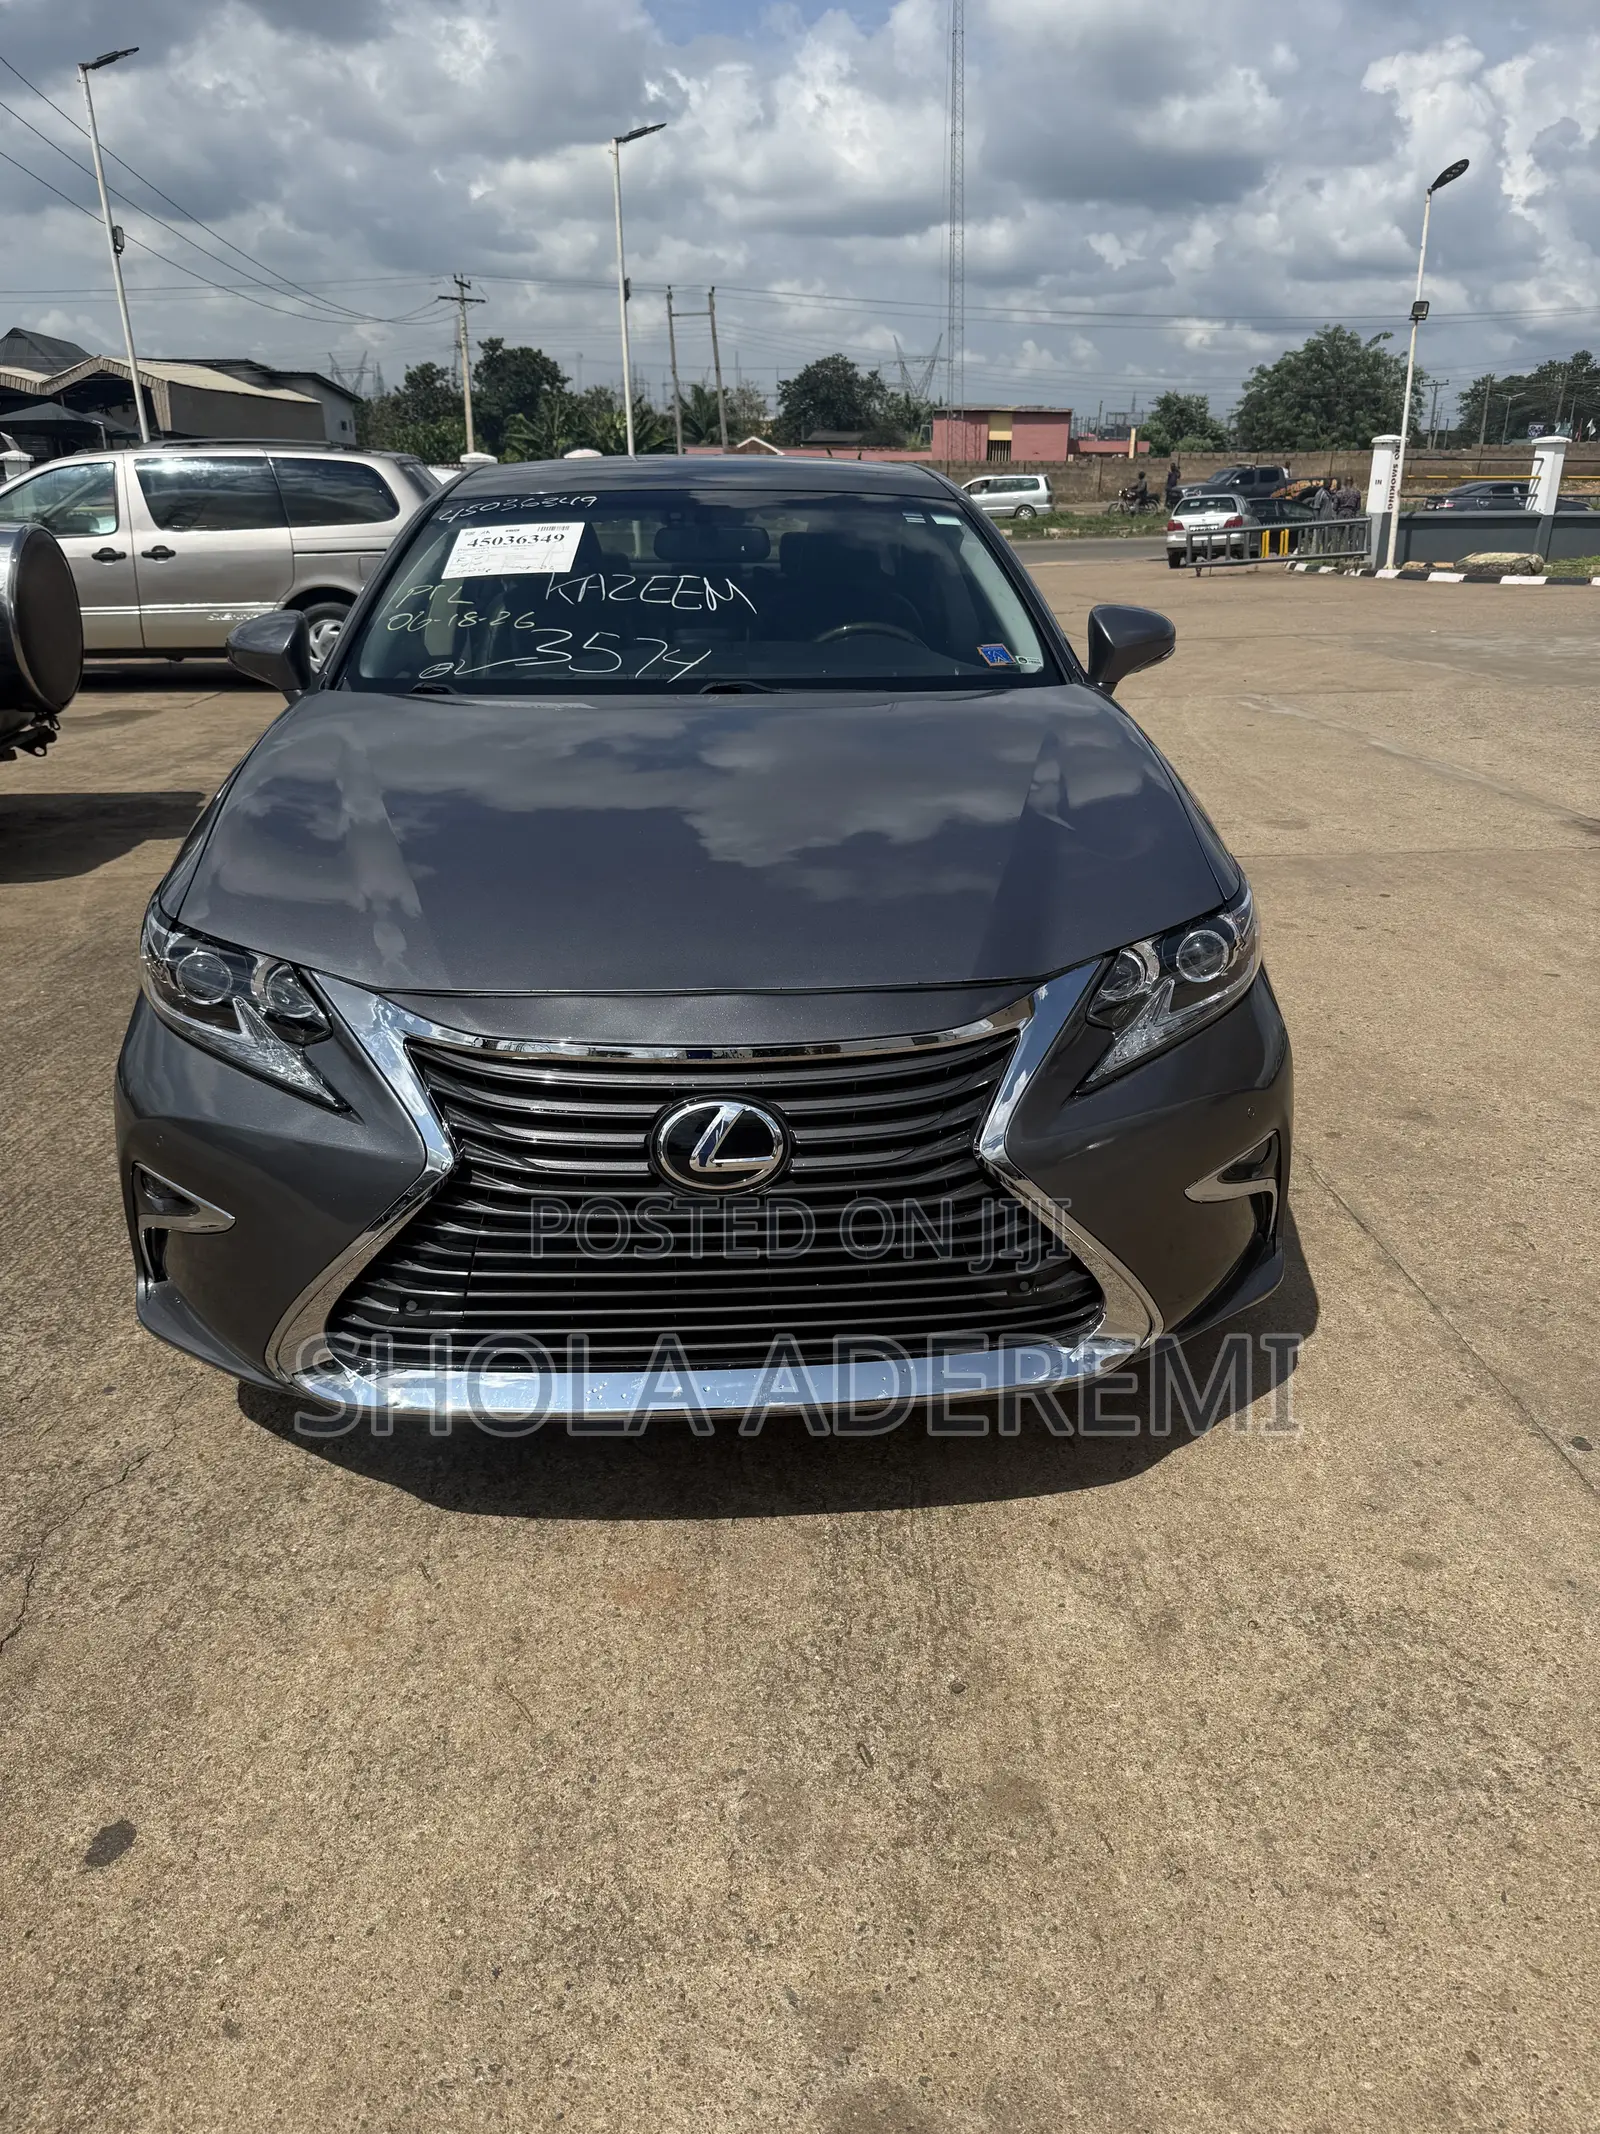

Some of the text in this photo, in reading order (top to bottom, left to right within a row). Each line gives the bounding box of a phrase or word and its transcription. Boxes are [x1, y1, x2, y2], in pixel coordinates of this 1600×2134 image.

[438, 495, 598, 524] 45036349
[466, 533, 565, 548] 45036349
[545, 572, 758, 615] KAZEEM
